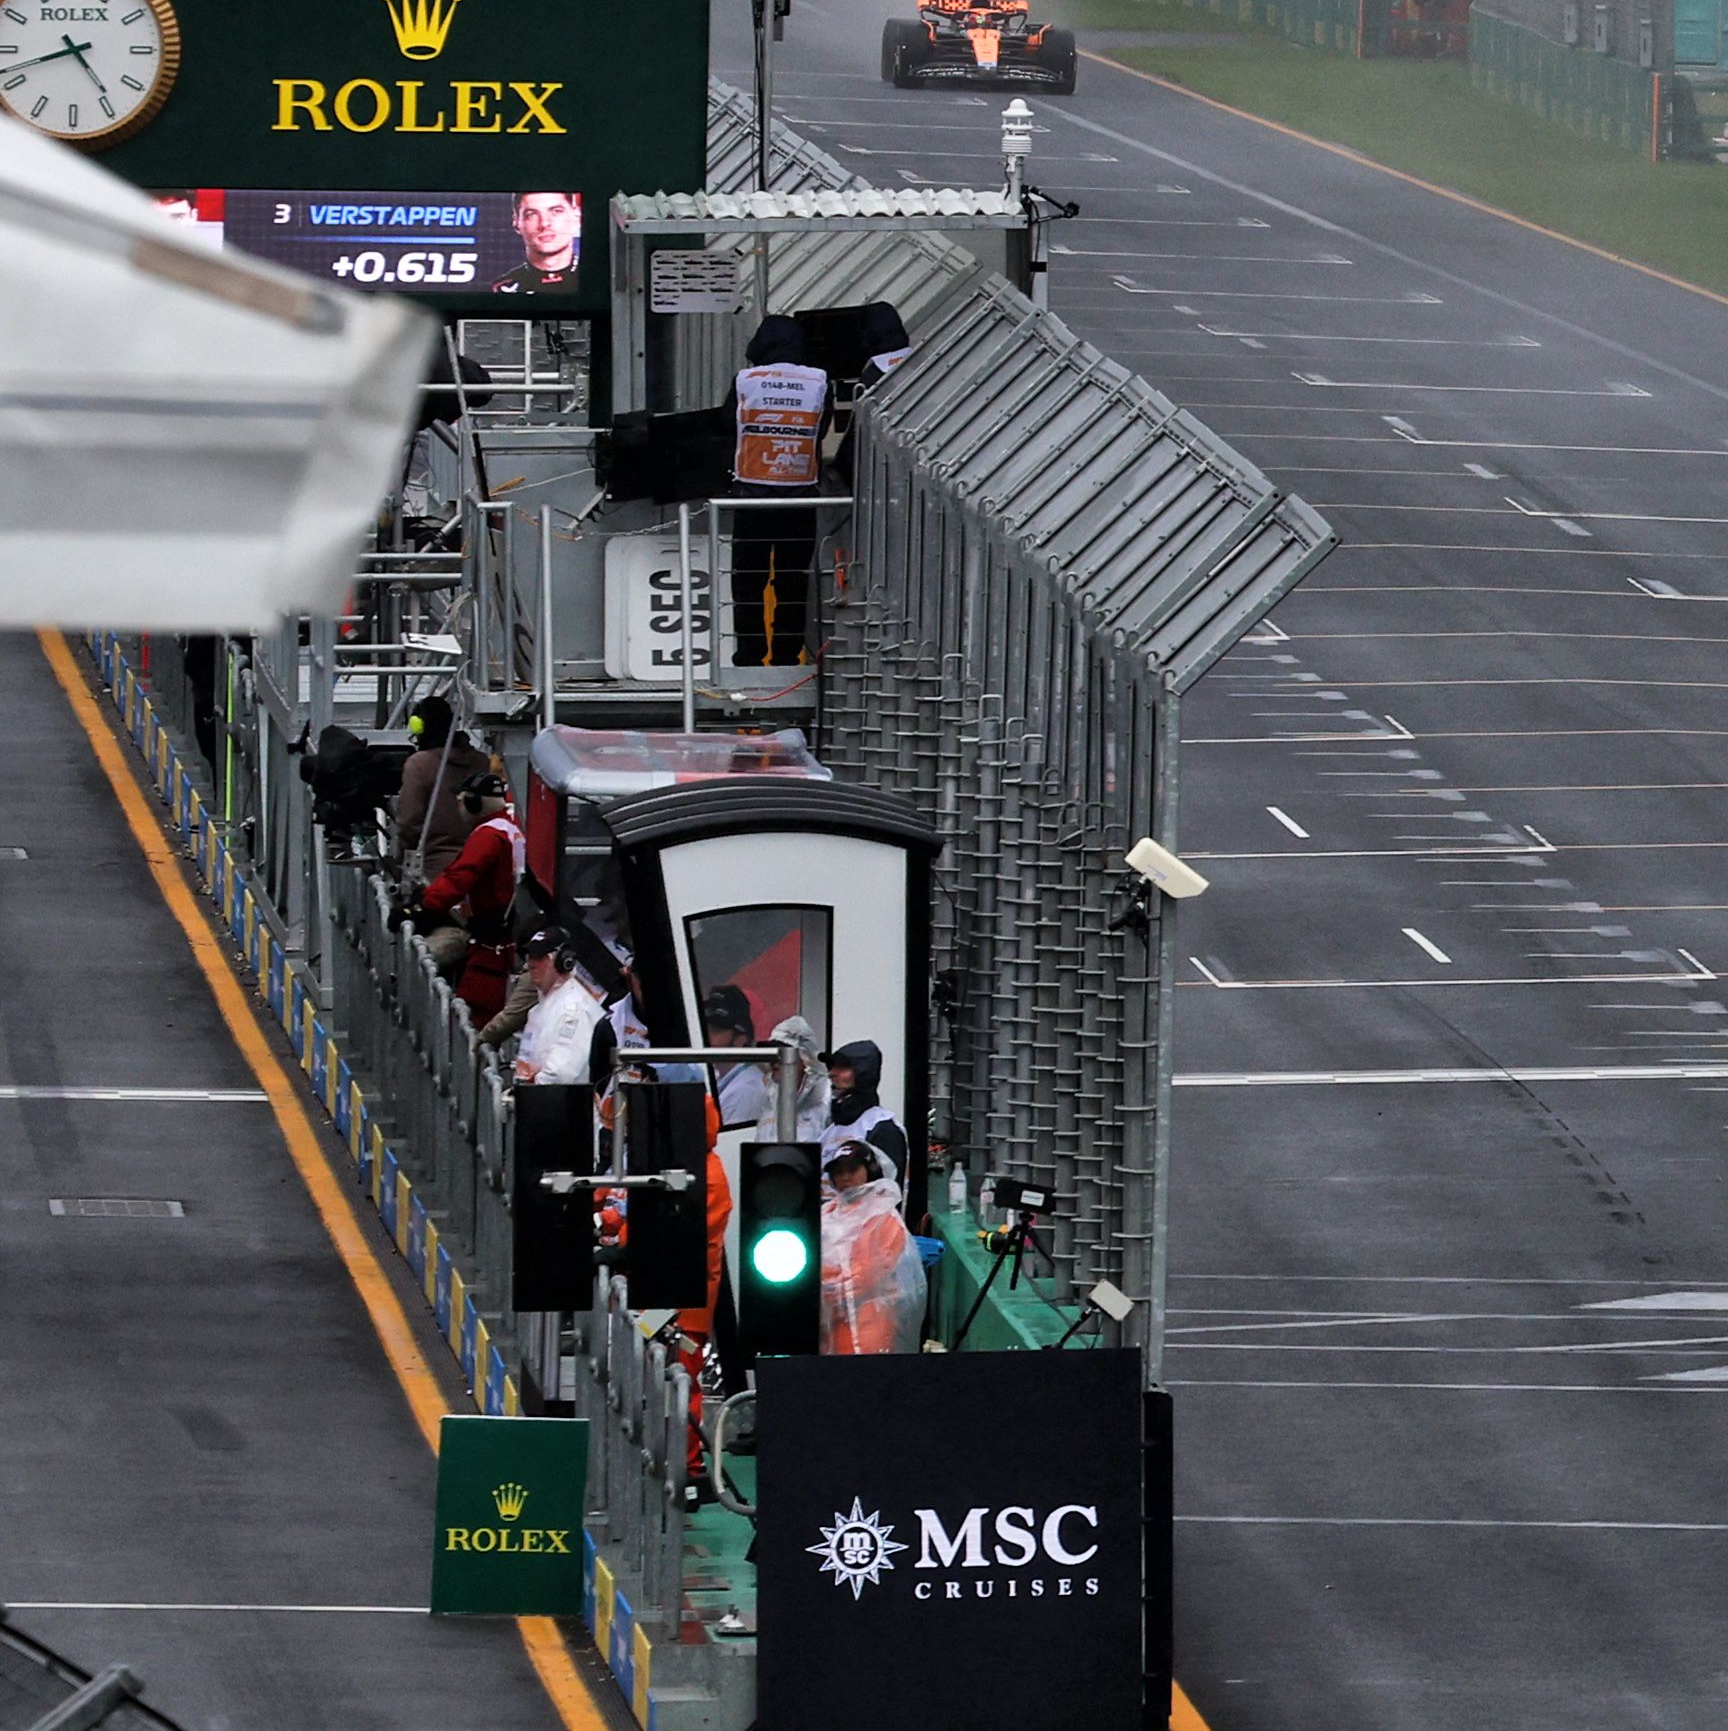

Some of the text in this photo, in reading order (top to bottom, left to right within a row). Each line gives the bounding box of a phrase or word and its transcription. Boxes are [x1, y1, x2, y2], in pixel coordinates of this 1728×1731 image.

[40, 7, 109, 22] ROLEX
[271, 78, 567, 134] ROLEX
[273, 204, 478, 226] 3 VERSTAPPEN
[332, 251, 478, 283] +0.615
[763, 397, 802, 407] STARTER
[771, 439, 803, 452] PIT
[648, 570, 711, 635] SEC
[445, 1527, 570, 1554] ROLEX
[914, 1505, 1099, 1568] MSC
[914, 1580, 1099, 1599] CRUISES
